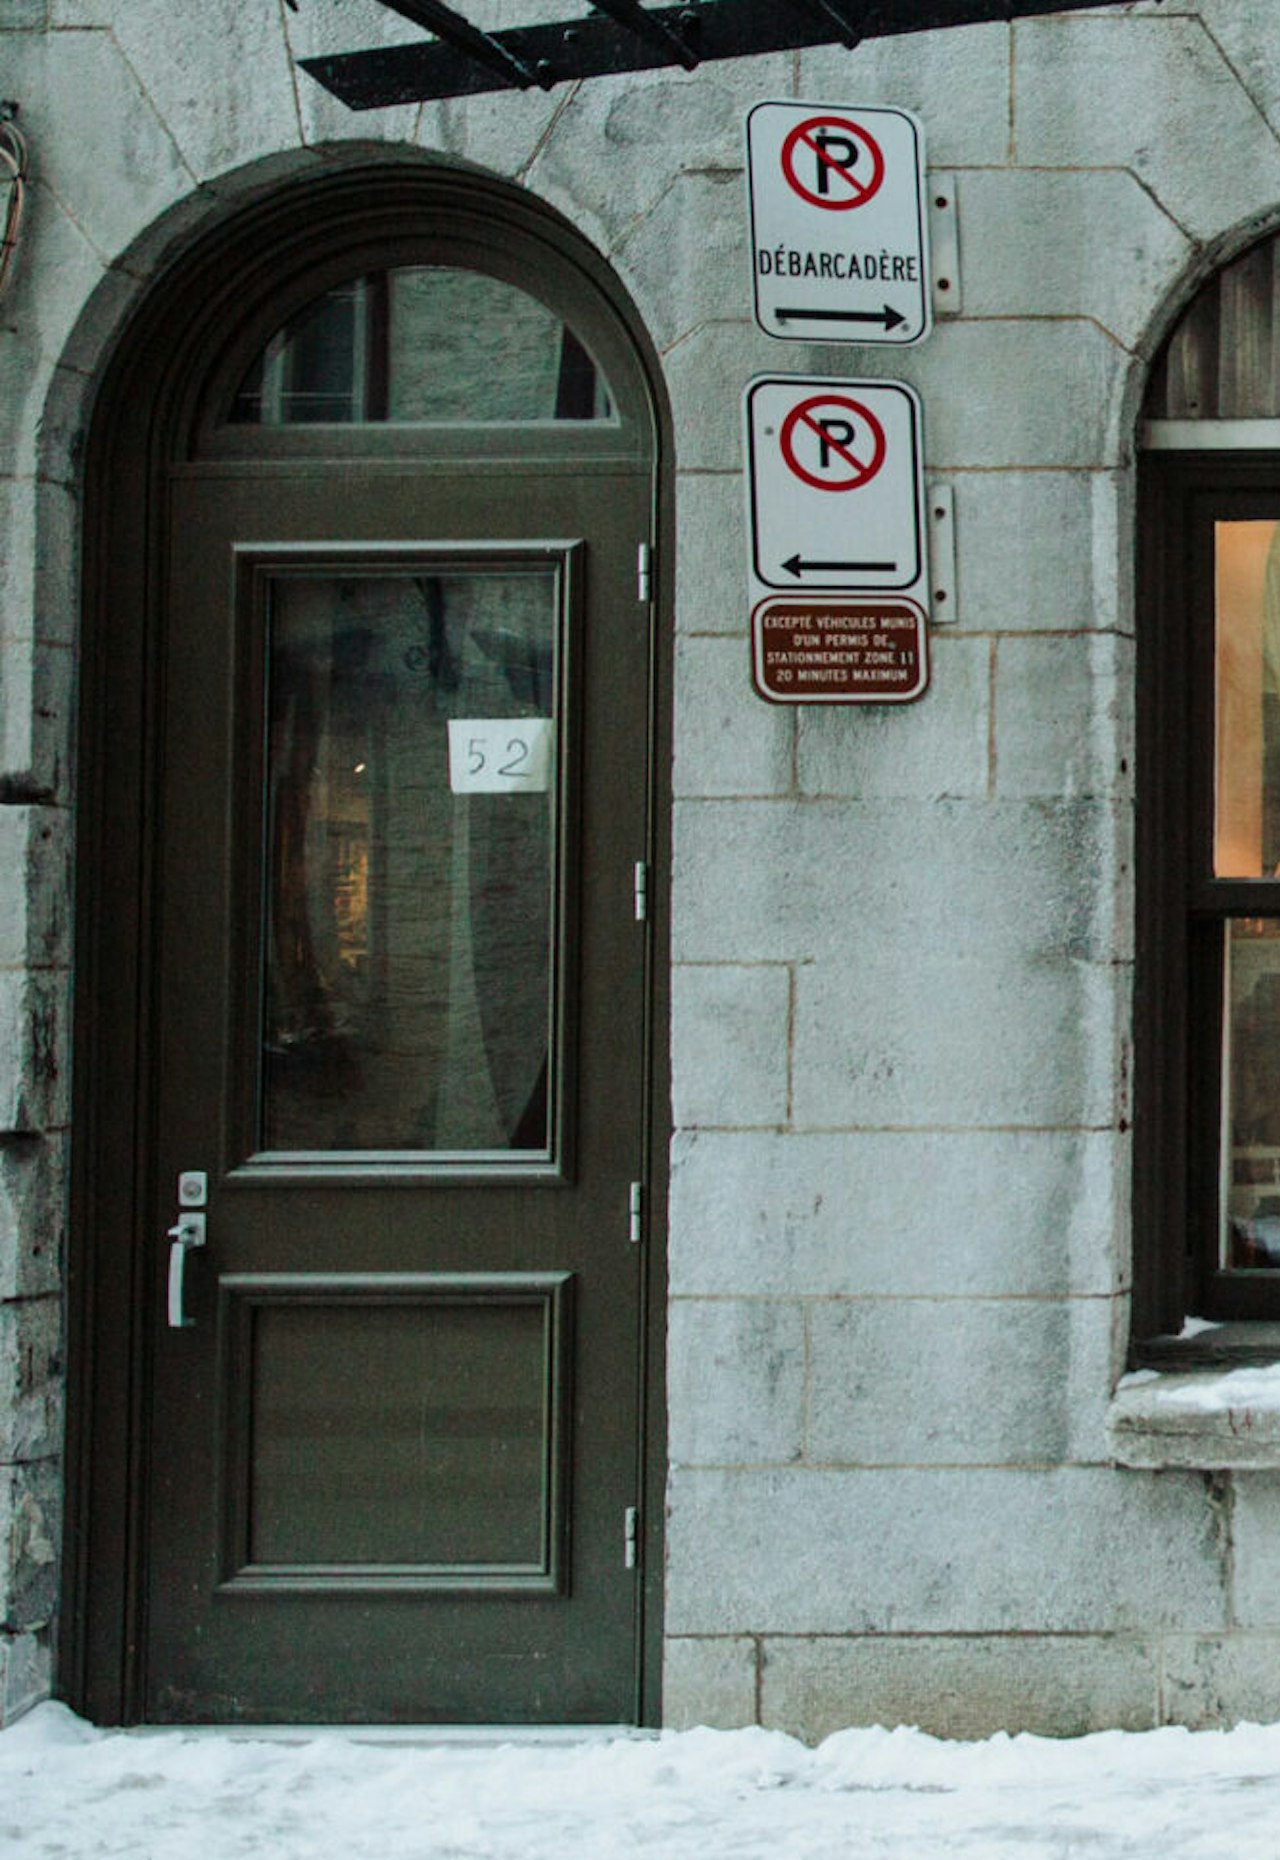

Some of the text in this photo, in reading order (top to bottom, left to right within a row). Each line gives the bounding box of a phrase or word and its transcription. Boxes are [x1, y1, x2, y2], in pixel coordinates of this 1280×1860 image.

[759, 244, 919, 281] DÉBARCADÈRE
[764, 614, 916, 629] EXCEPTÉ VÉHICULES MUNIS
[793, 634, 888, 647] D'UN PERMIS DE
[767, 651, 860, 665] STATIONNEMENT
[865, 651, 894, 665] ZONE
[776, 669, 907, 682] 20 MINUTES MAXIMUM
[468, 737, 534, 778] 52
